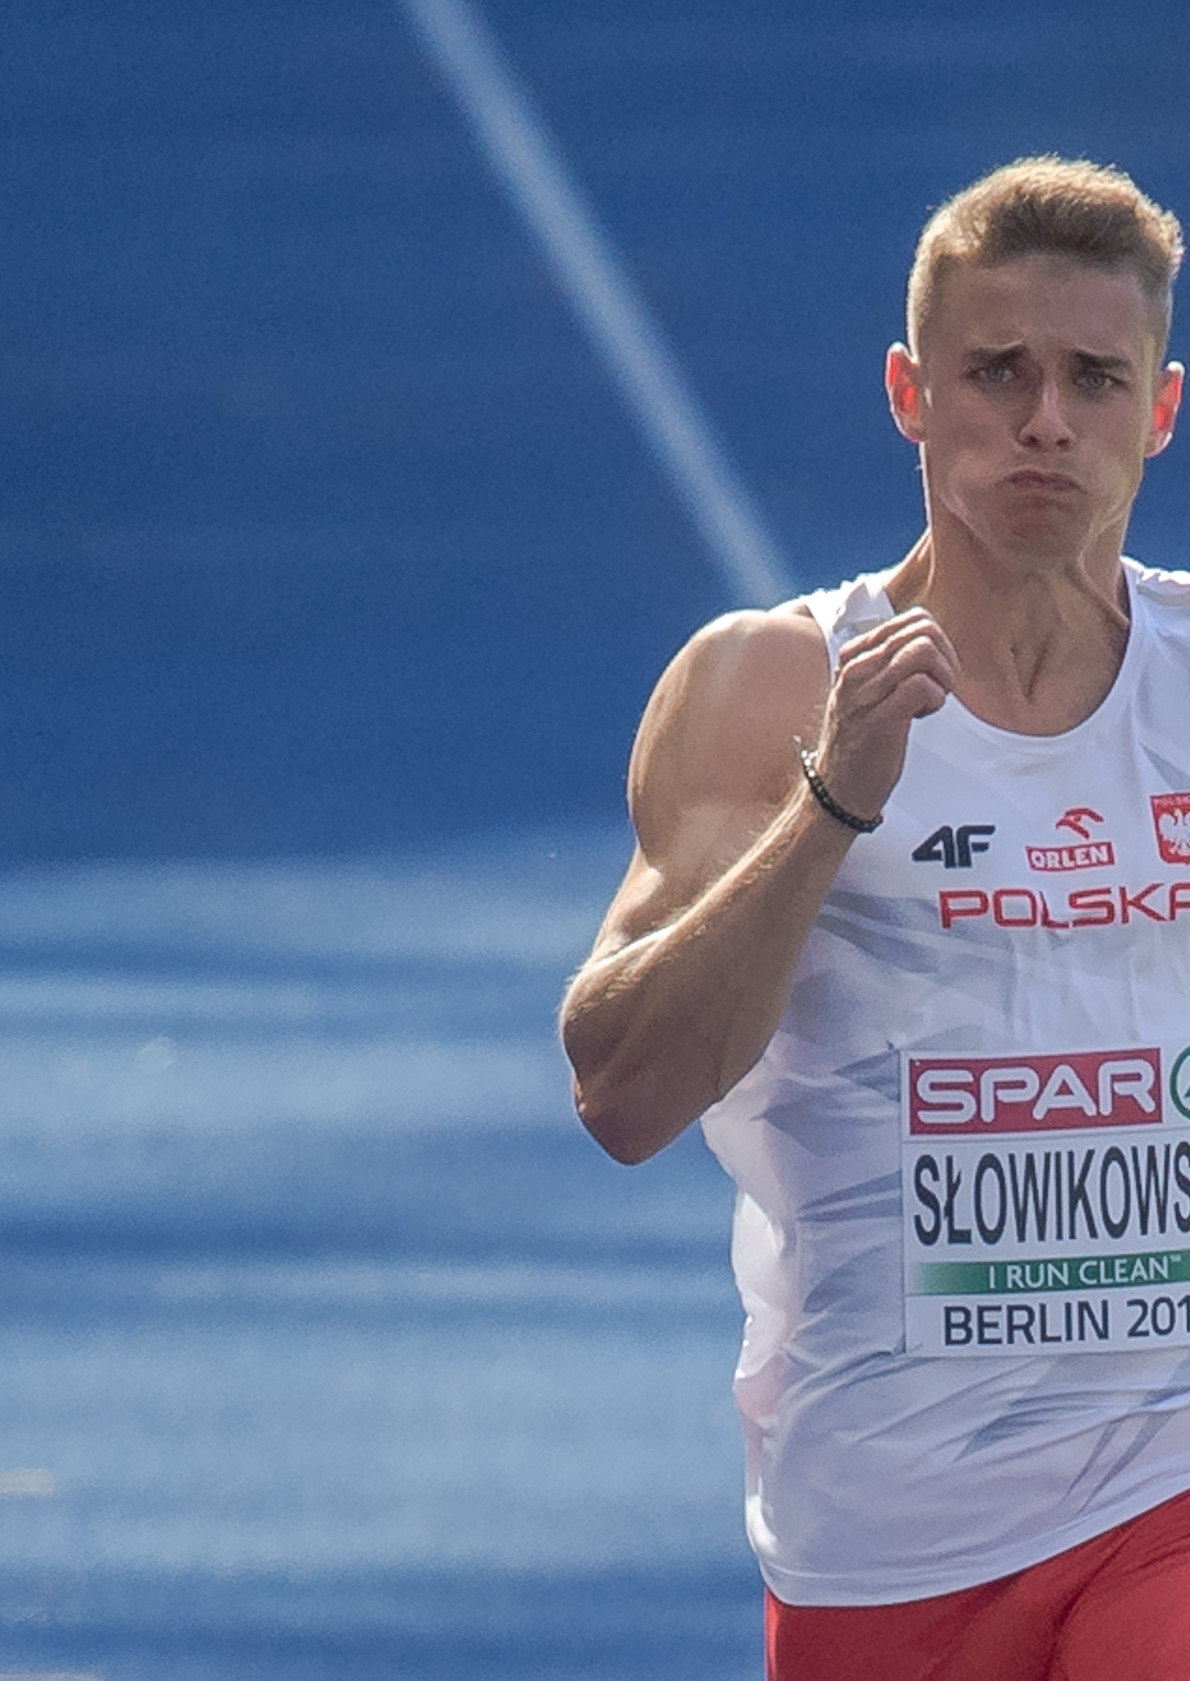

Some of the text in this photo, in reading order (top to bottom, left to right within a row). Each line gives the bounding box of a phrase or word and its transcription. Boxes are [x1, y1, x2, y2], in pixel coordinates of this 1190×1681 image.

[911, 825, 996, 869] 4F
[1031, 845, 1109, 869] ORLEN
[916, 1058, 1156, 1125] SPAR
[989, 1266, 996, 1288] I
[1007, 1262, 1069, 1289] RUN
[944, 1299, 1110, 1347] BERLIN
